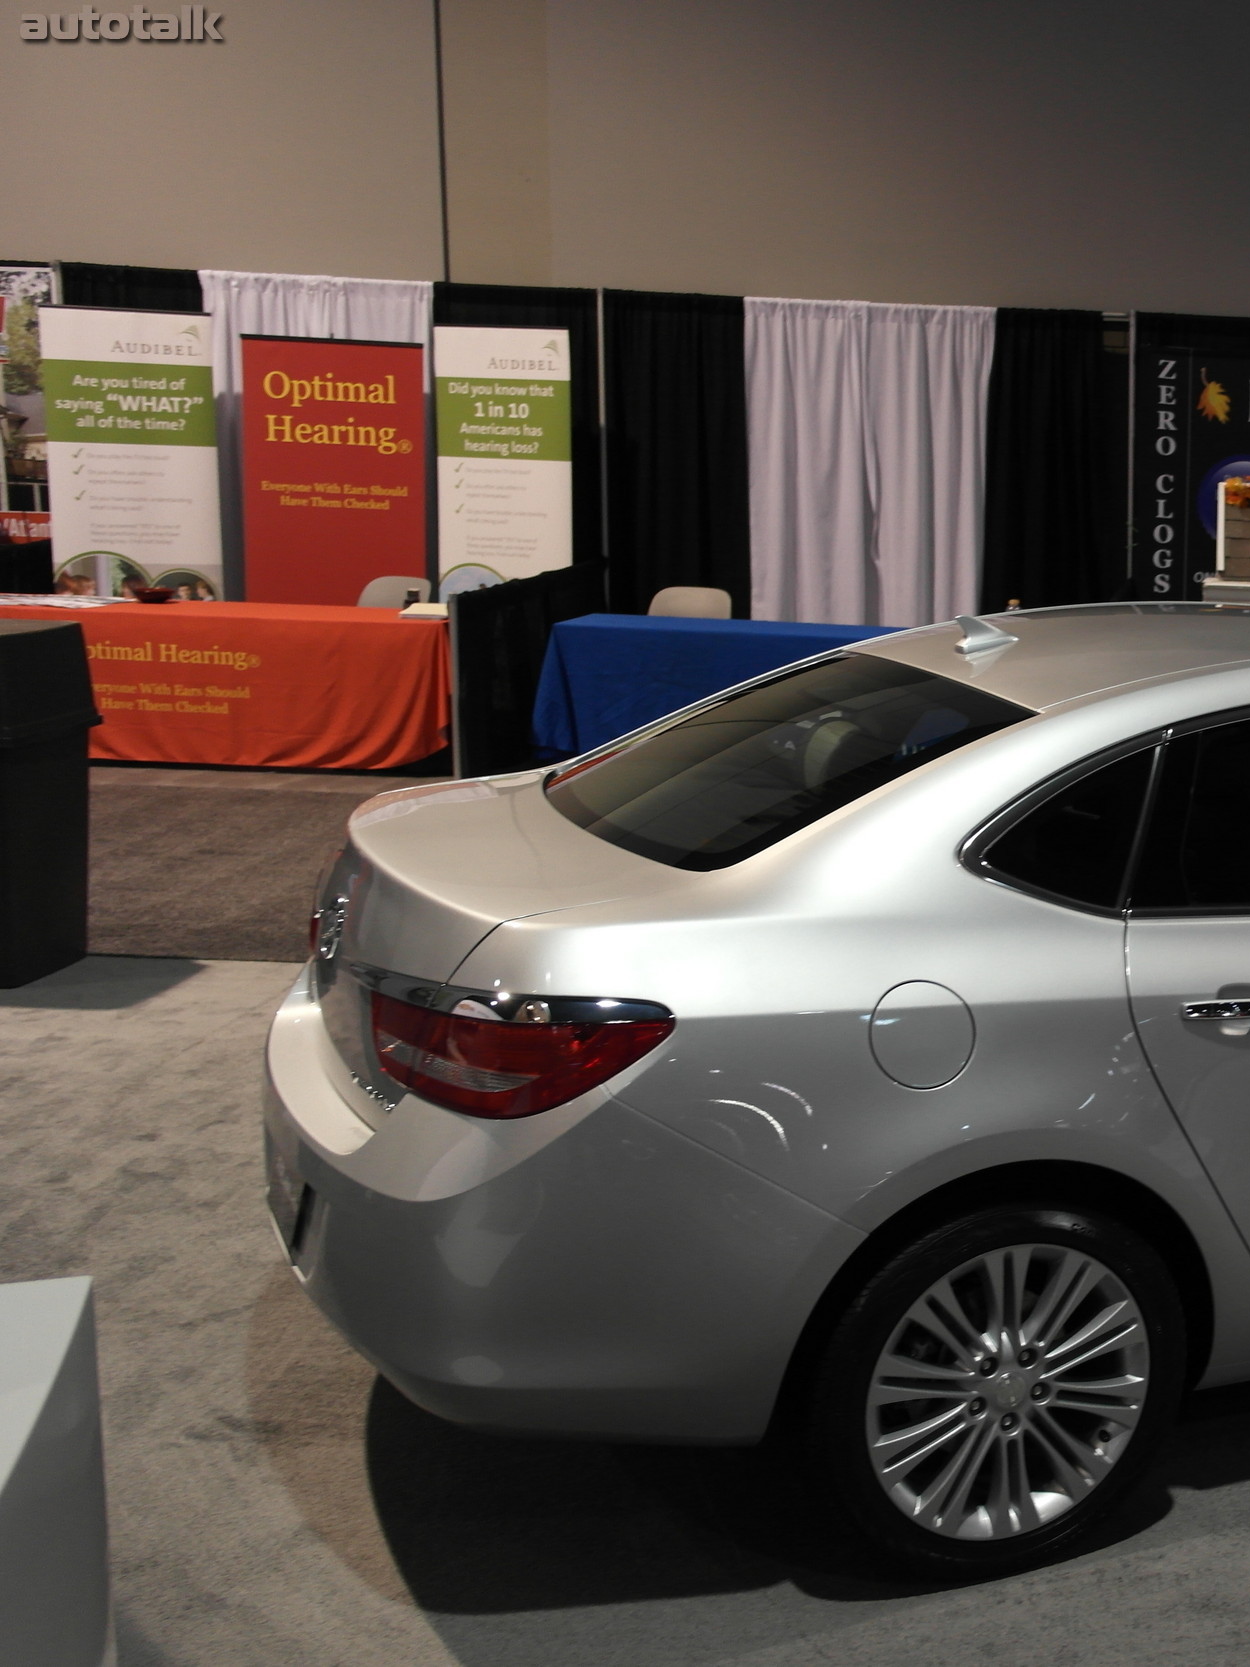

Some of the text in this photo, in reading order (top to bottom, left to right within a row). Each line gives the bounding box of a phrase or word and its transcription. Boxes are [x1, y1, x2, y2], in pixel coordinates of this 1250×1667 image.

[111, 340, 199, 357] AUDIBEL
[487, 357, 556, 371] AUDIBEL
[72, 374, 186, 391] Are you tired of
[263, 370, 397, 408] Optimal
[448, 382, 555, 398] Did you know that
[55, 397, 105, 414] saying
[474, 401, 530, 419] 1 in 10
[1155, 359, 1178, 456] ZERO
[76, 415, 186, 431] all of the time?
[459, 422, 544, 437] Americans has
[464, 439, 540, 456] hearing loss?
[261, 480, 409, 497] Everyone With Ears Should
[280, 496, 391, 511] Have Them Checked
[1152, 474, 1175, 594] CLOGS
[138, 683, 172, 696] With
[173, 685, 203, 697] Ears
[205, 685, 251, 699] Should
[101, 697, 230, 715] Have Them Checked
